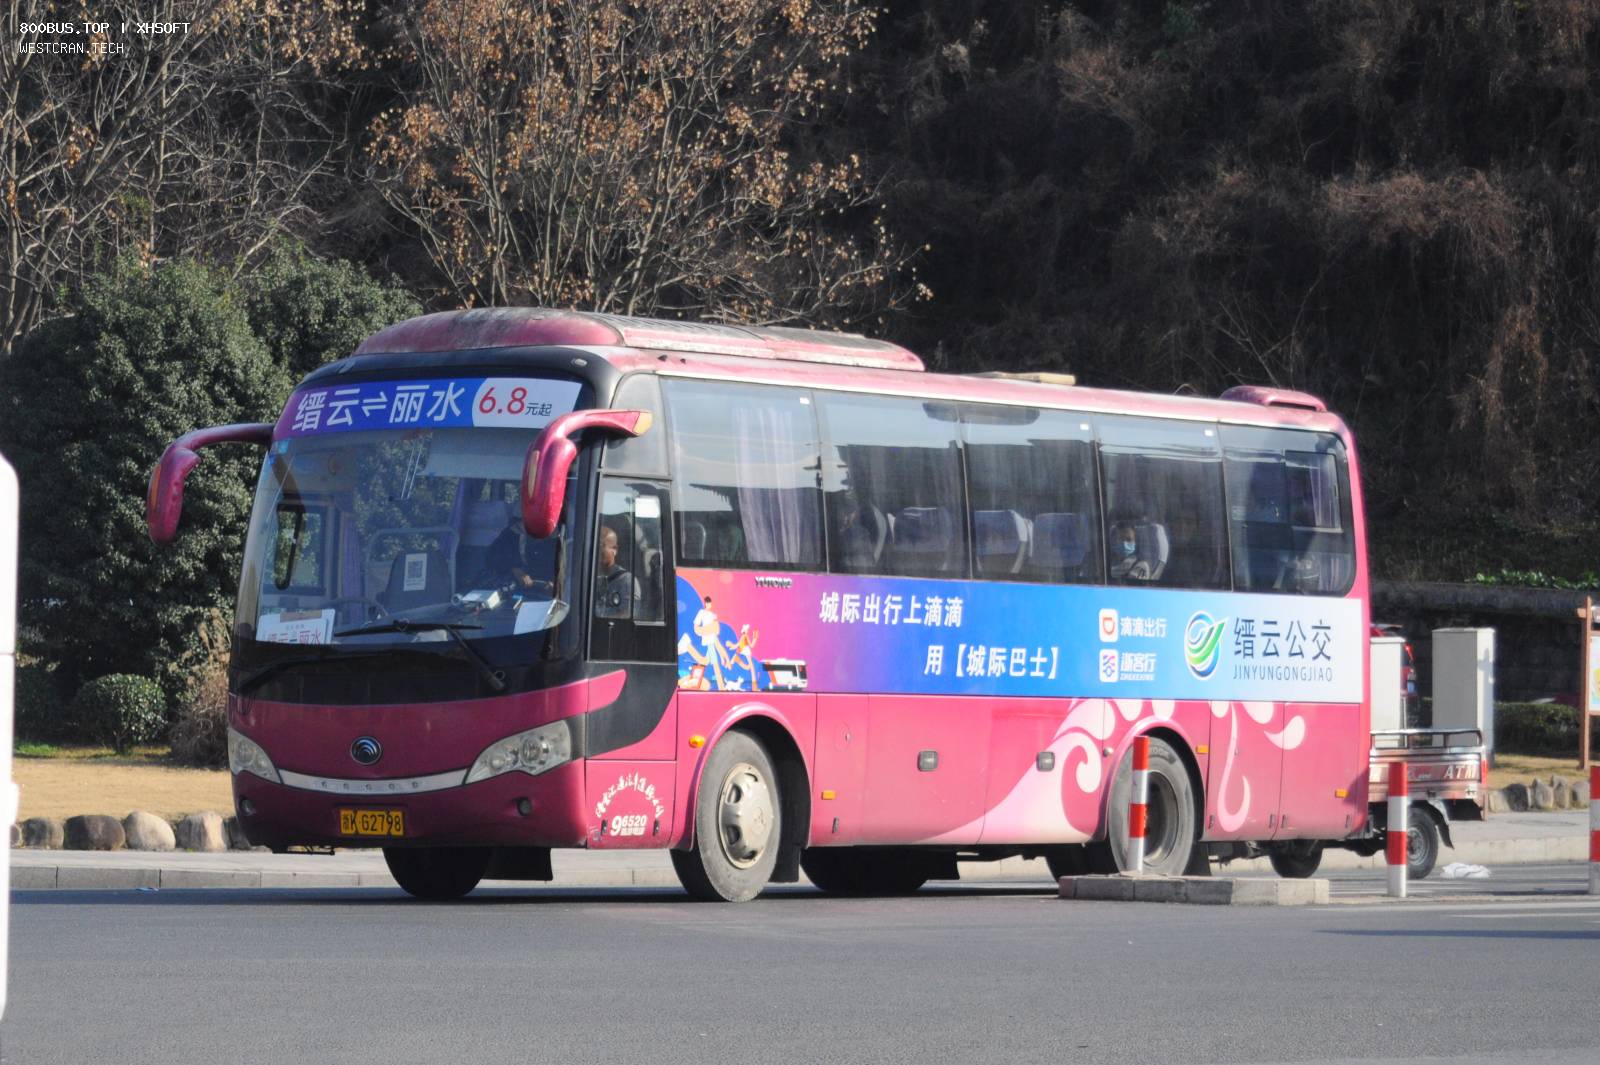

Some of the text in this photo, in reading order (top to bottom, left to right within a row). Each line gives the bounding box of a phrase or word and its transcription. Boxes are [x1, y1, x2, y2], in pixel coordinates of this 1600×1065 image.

[292, 382, 465, 431] 缙云 丽水
[819, 591, 964, 628] 城际出行上滴滴
[1120, 616, 1168, 638] 滴滴出行
[1234, 617, 1332, 661] 缙云公交
[1233, 665, 1333, 682] JINYUNGONGJIAO
[610, 814, 647, 836] 96520
